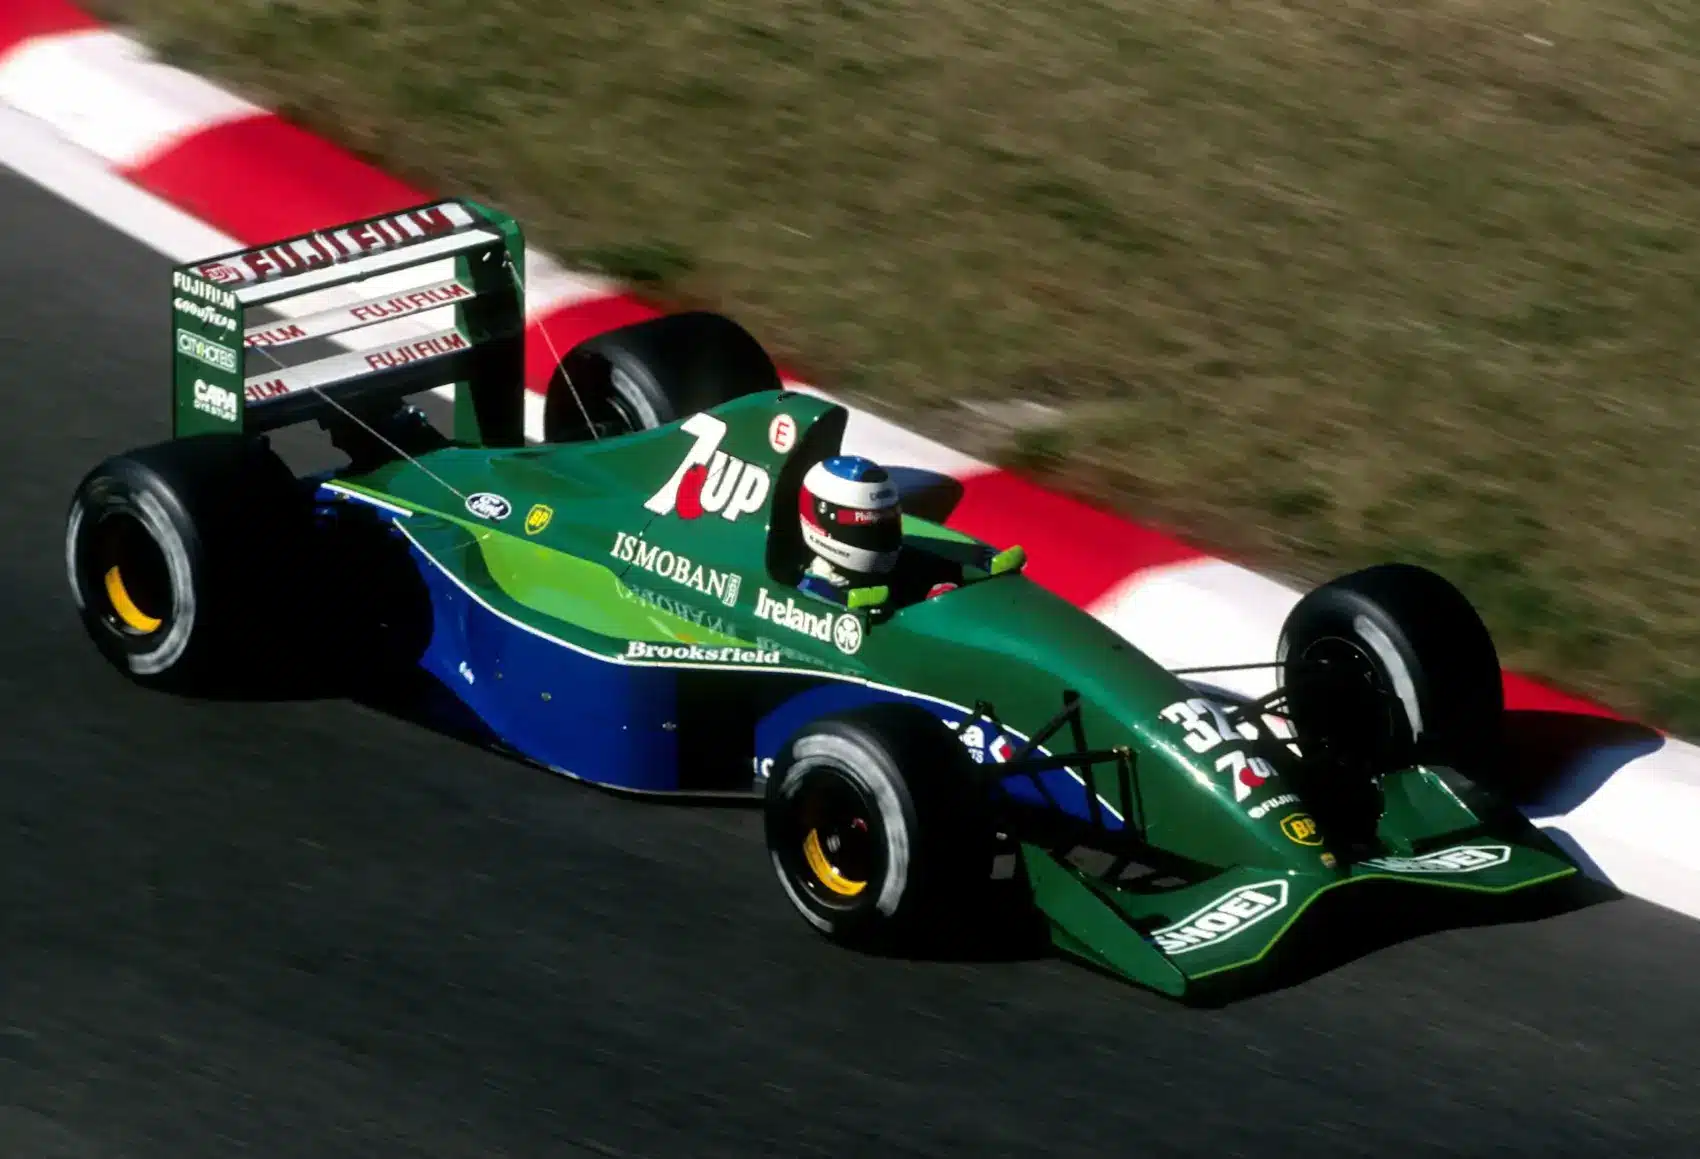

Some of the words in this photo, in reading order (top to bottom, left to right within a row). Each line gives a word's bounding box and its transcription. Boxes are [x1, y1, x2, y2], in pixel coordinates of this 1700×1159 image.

[173, 271, 236, 311] FUJIFILM
[774, 423, 789, 448] E
[643, 412, 770, 521] 7UP
[610, 531, 729, 599] ISMOBAN
[754, 587, 833, 642] Ireland
[627, 641, 780, 664] Brooksfield
